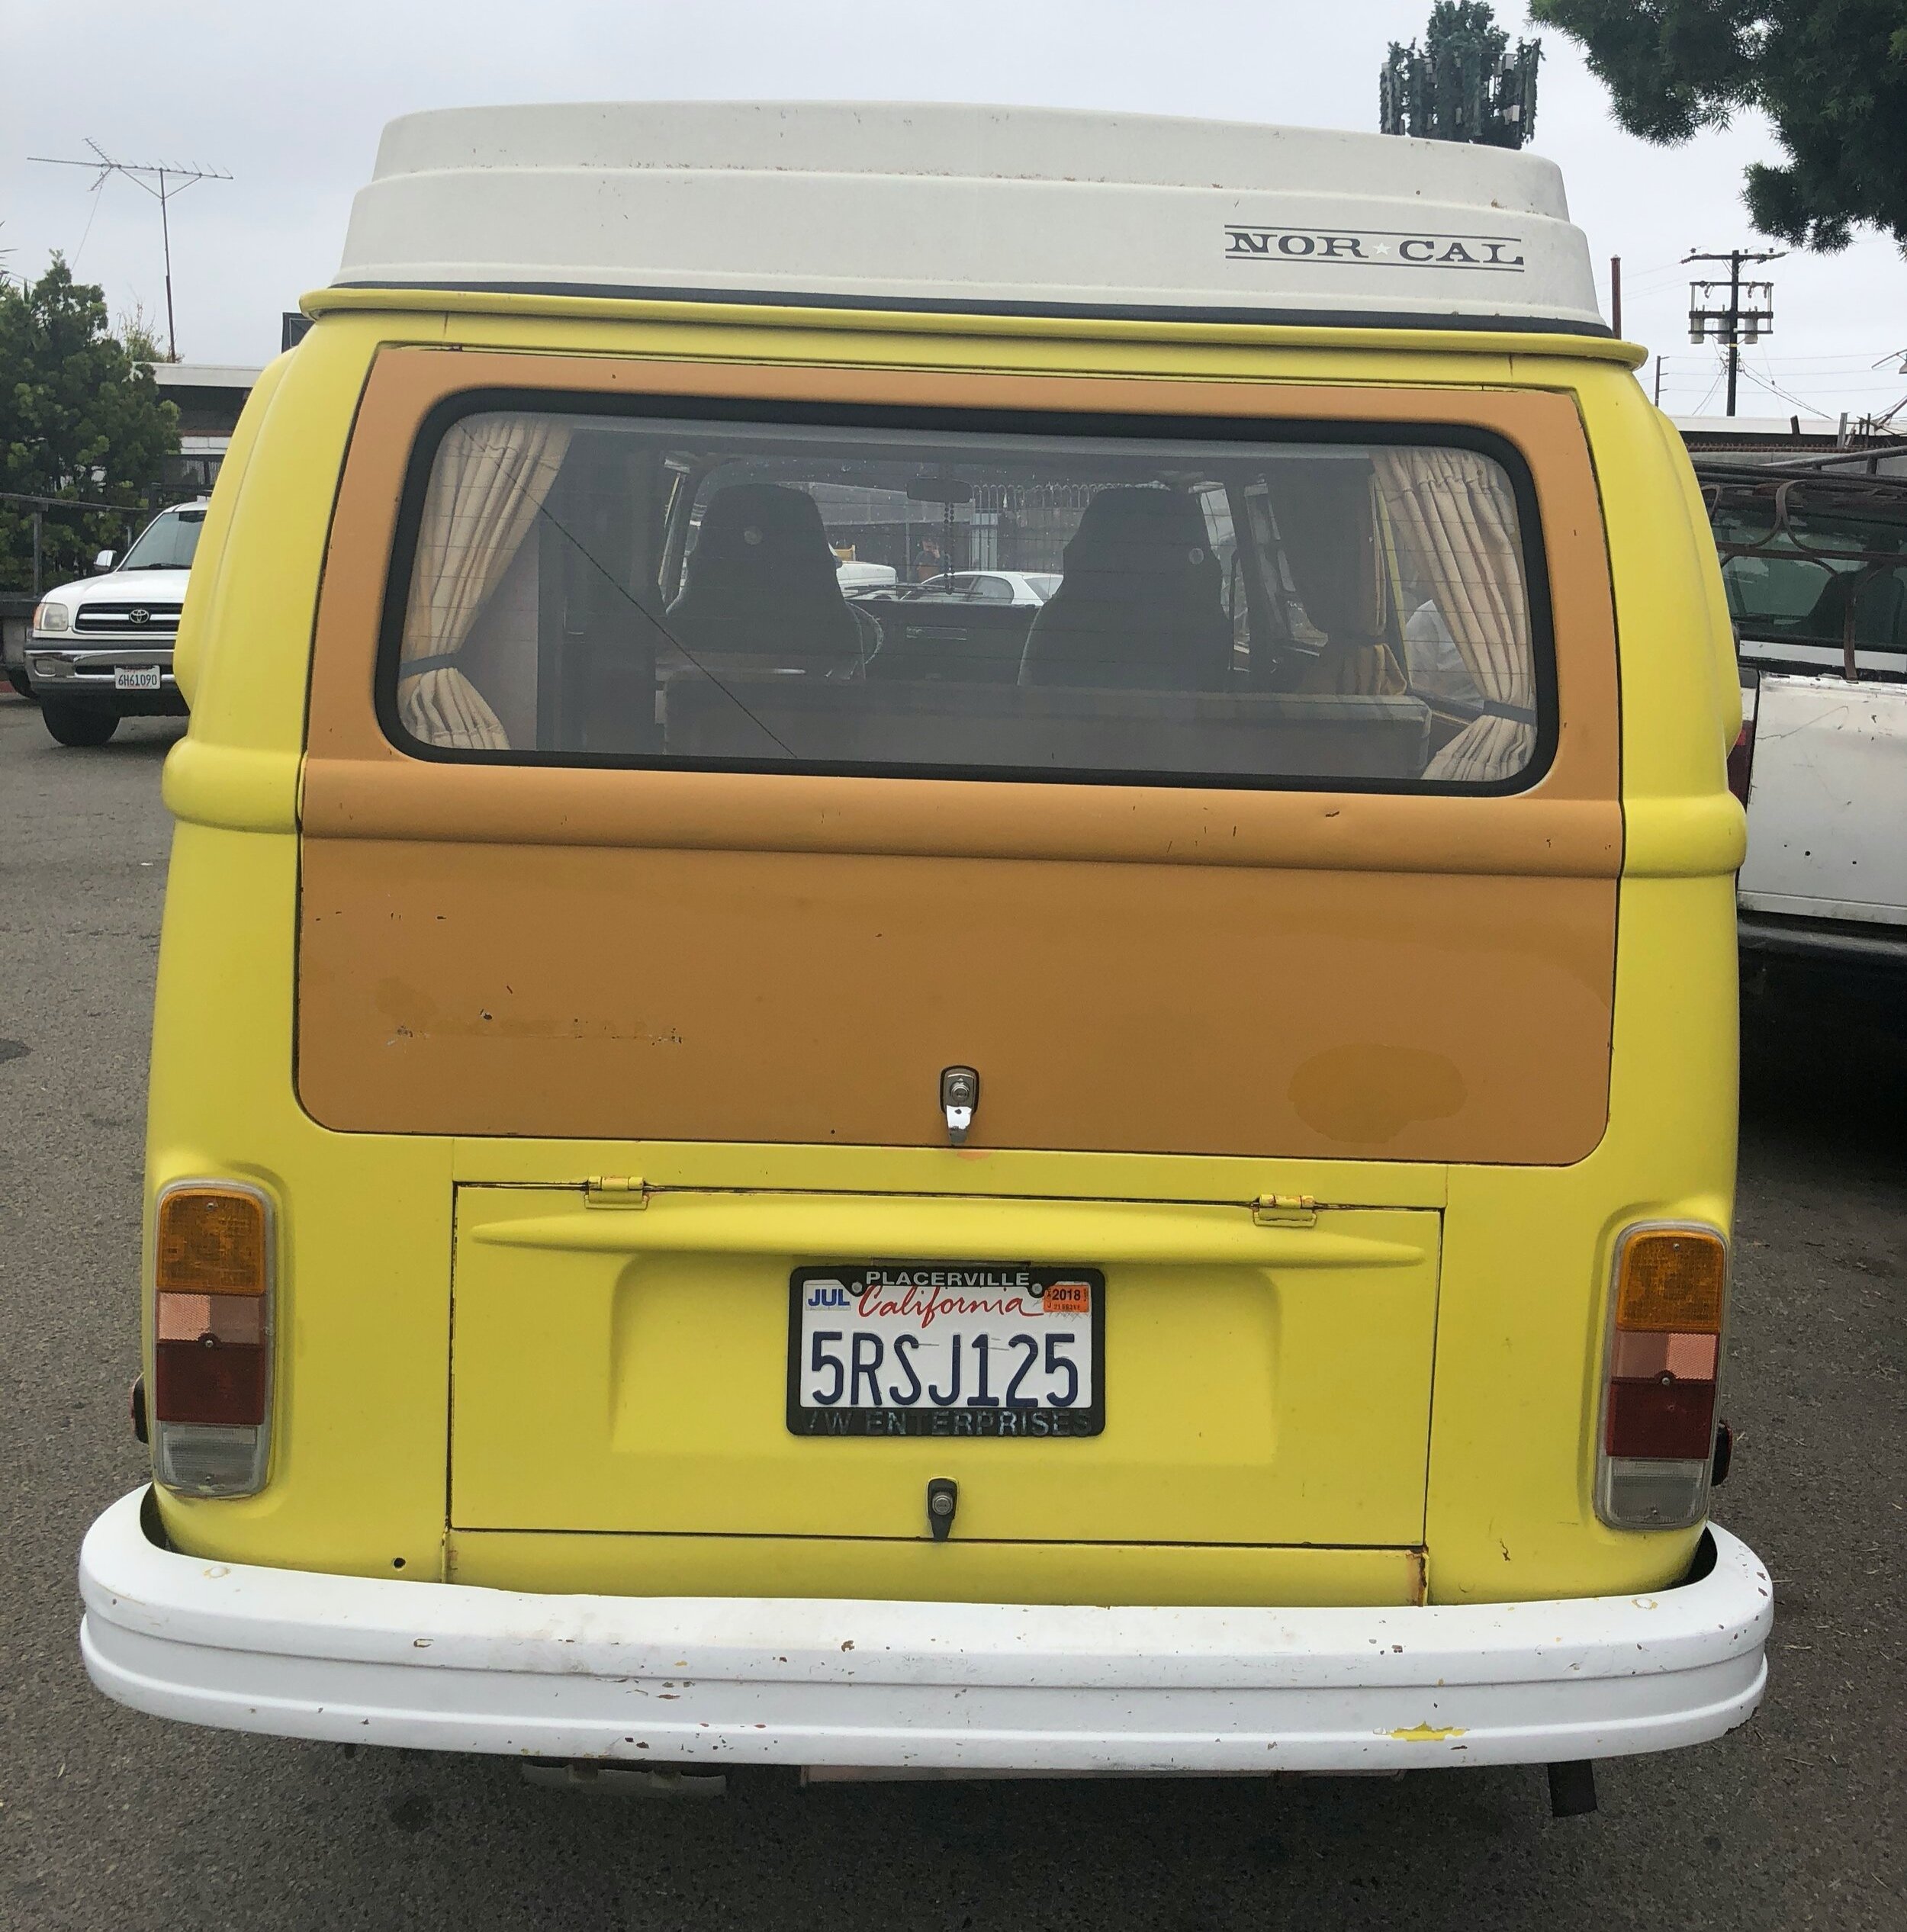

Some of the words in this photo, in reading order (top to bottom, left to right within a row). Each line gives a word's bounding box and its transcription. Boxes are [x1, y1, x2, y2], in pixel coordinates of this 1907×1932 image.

[1224, 231, 1369, 259] NOR
[1398, 239, 1525, 265] CAL
[866, 1271, 1030, 1287] PLACERVILLE
[808, 1288, 851, 1307] JUL
[857, 1284, 1044, 1329] California
[1052, 1288, 1081, 1301] 2018
[811, 1331, 1079, 1408] 5RSJ125
[865, 1410, 1092, 1436] ENTERPRISES
